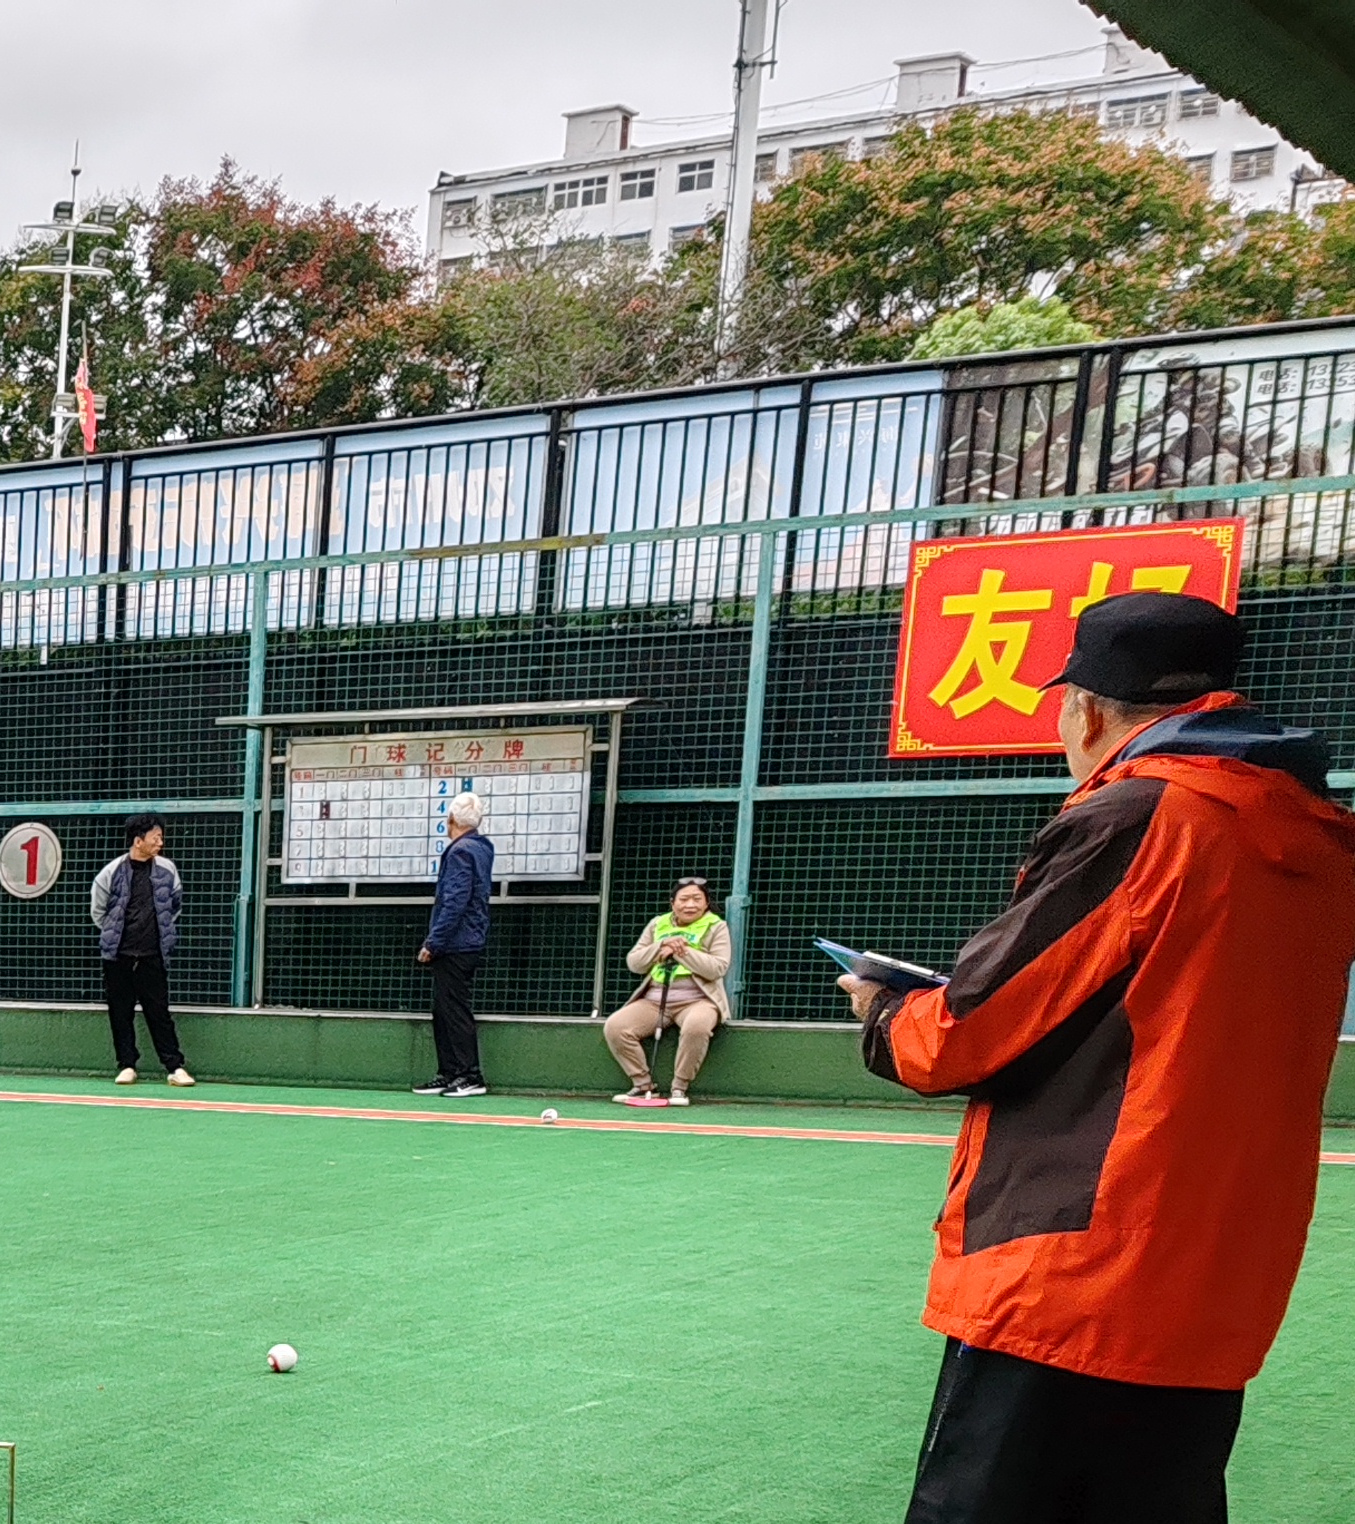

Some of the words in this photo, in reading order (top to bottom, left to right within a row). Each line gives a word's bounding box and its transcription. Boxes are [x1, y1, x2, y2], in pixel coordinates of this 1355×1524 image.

[349, 739, 524, 764] 门球记分牌
[438, 781, 447, 794] 2
[437, 800, 446, 814] 4
[437, 821, 445, 833] 6
[436, 840, 444, 852] 8
[20, 836, 40, 886] 1
